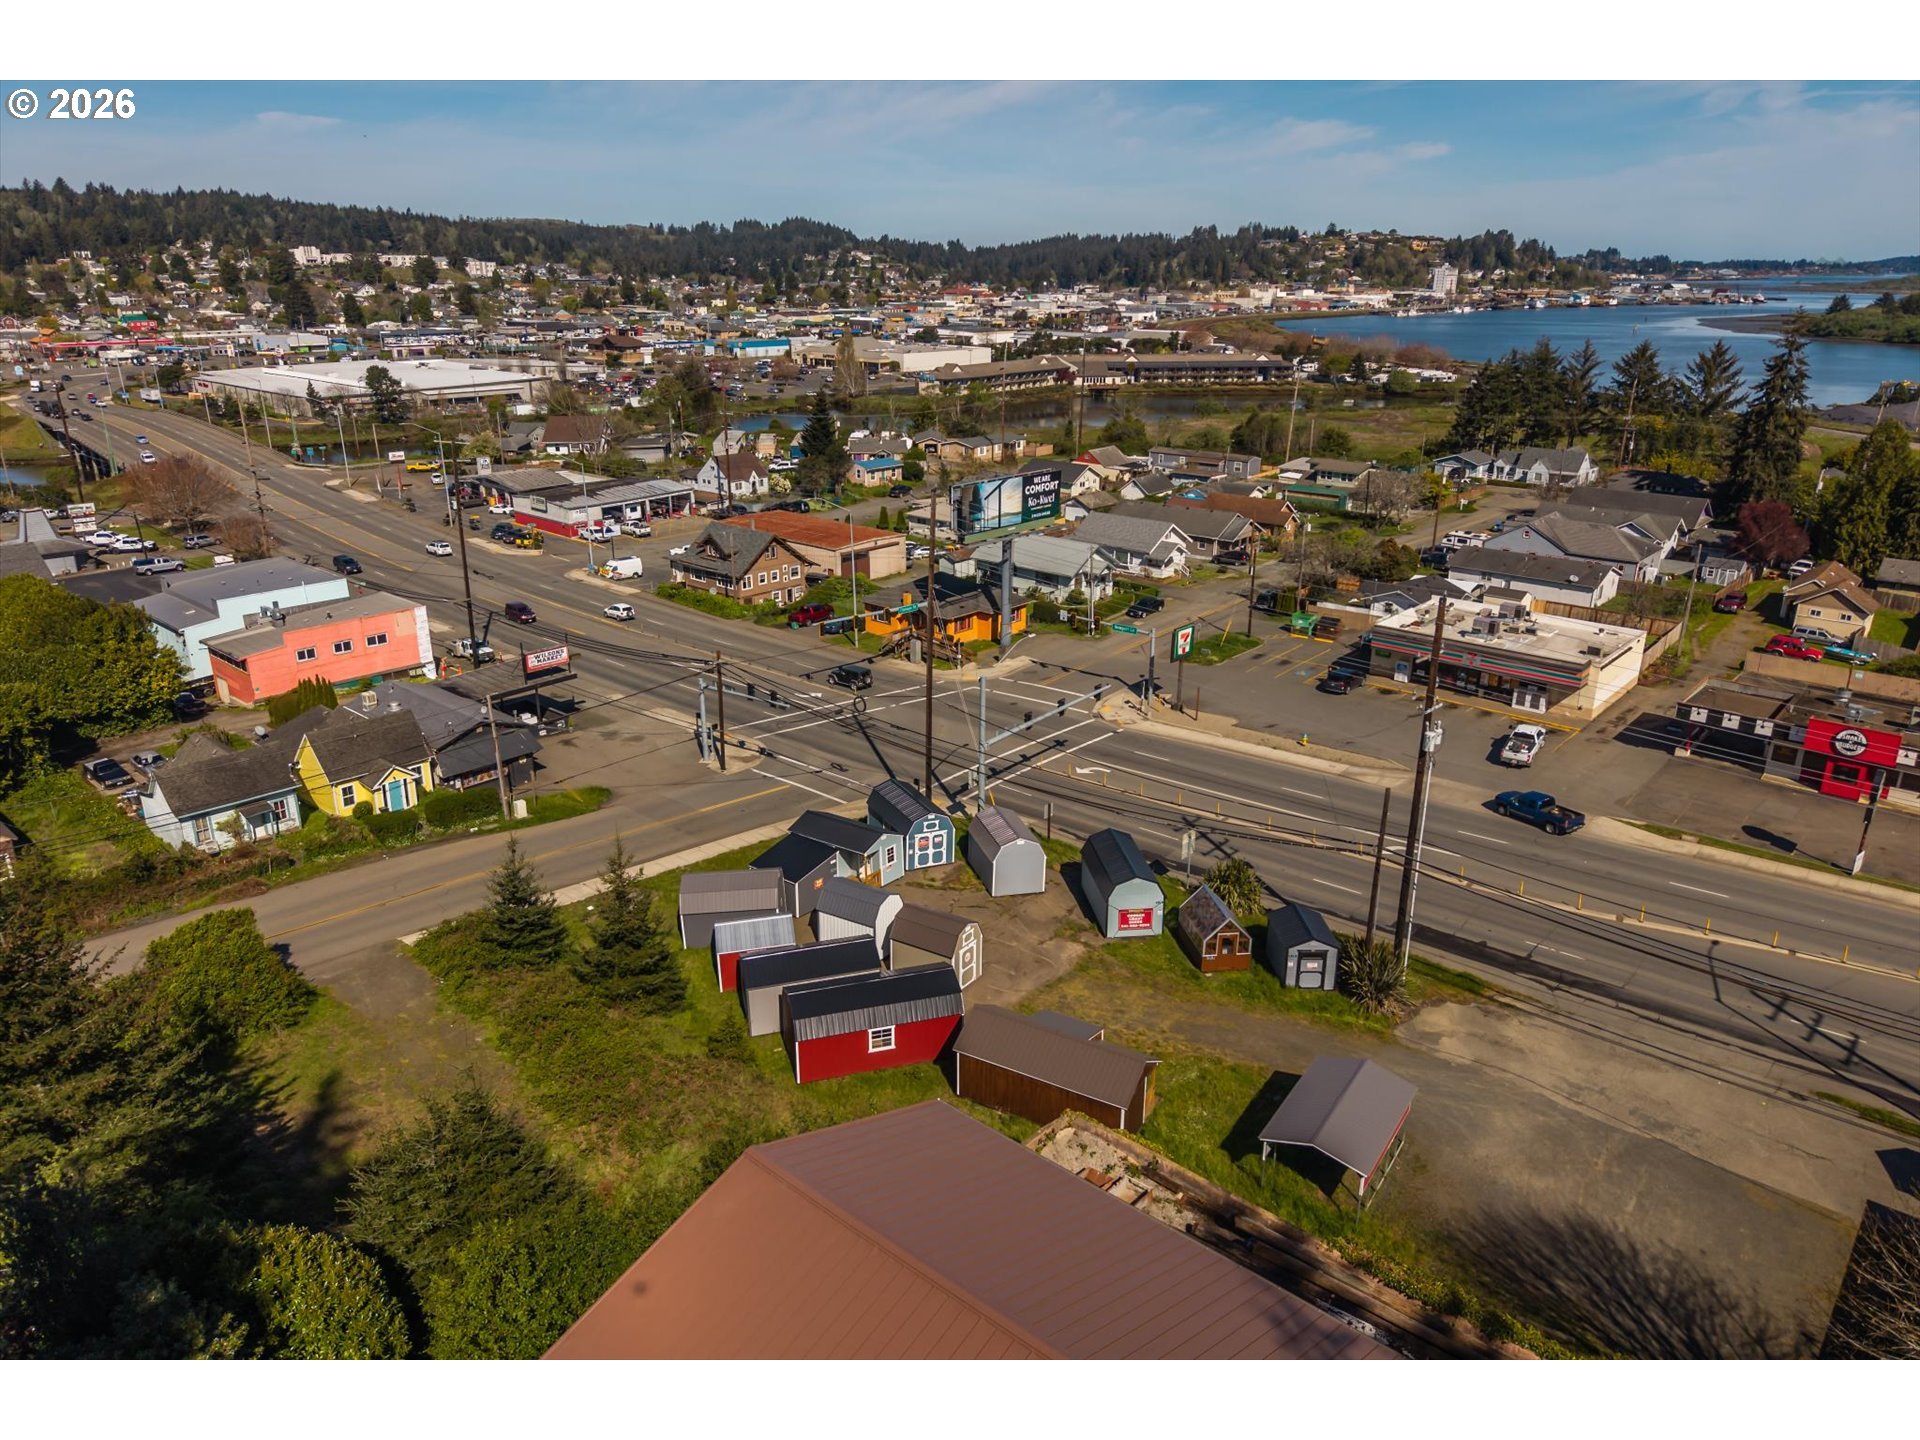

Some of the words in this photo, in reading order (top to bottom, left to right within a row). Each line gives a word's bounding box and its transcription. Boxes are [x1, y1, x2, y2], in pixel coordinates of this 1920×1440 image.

[1033, 476, 1041, 484] WE
[1041, 474, 1051, 482] ARE
[1024, 480, 1059, 495] COMFORT
[1027, 492, 1055, 507] Ko-Kwel
[536, 654, 563, 664] MARKET
